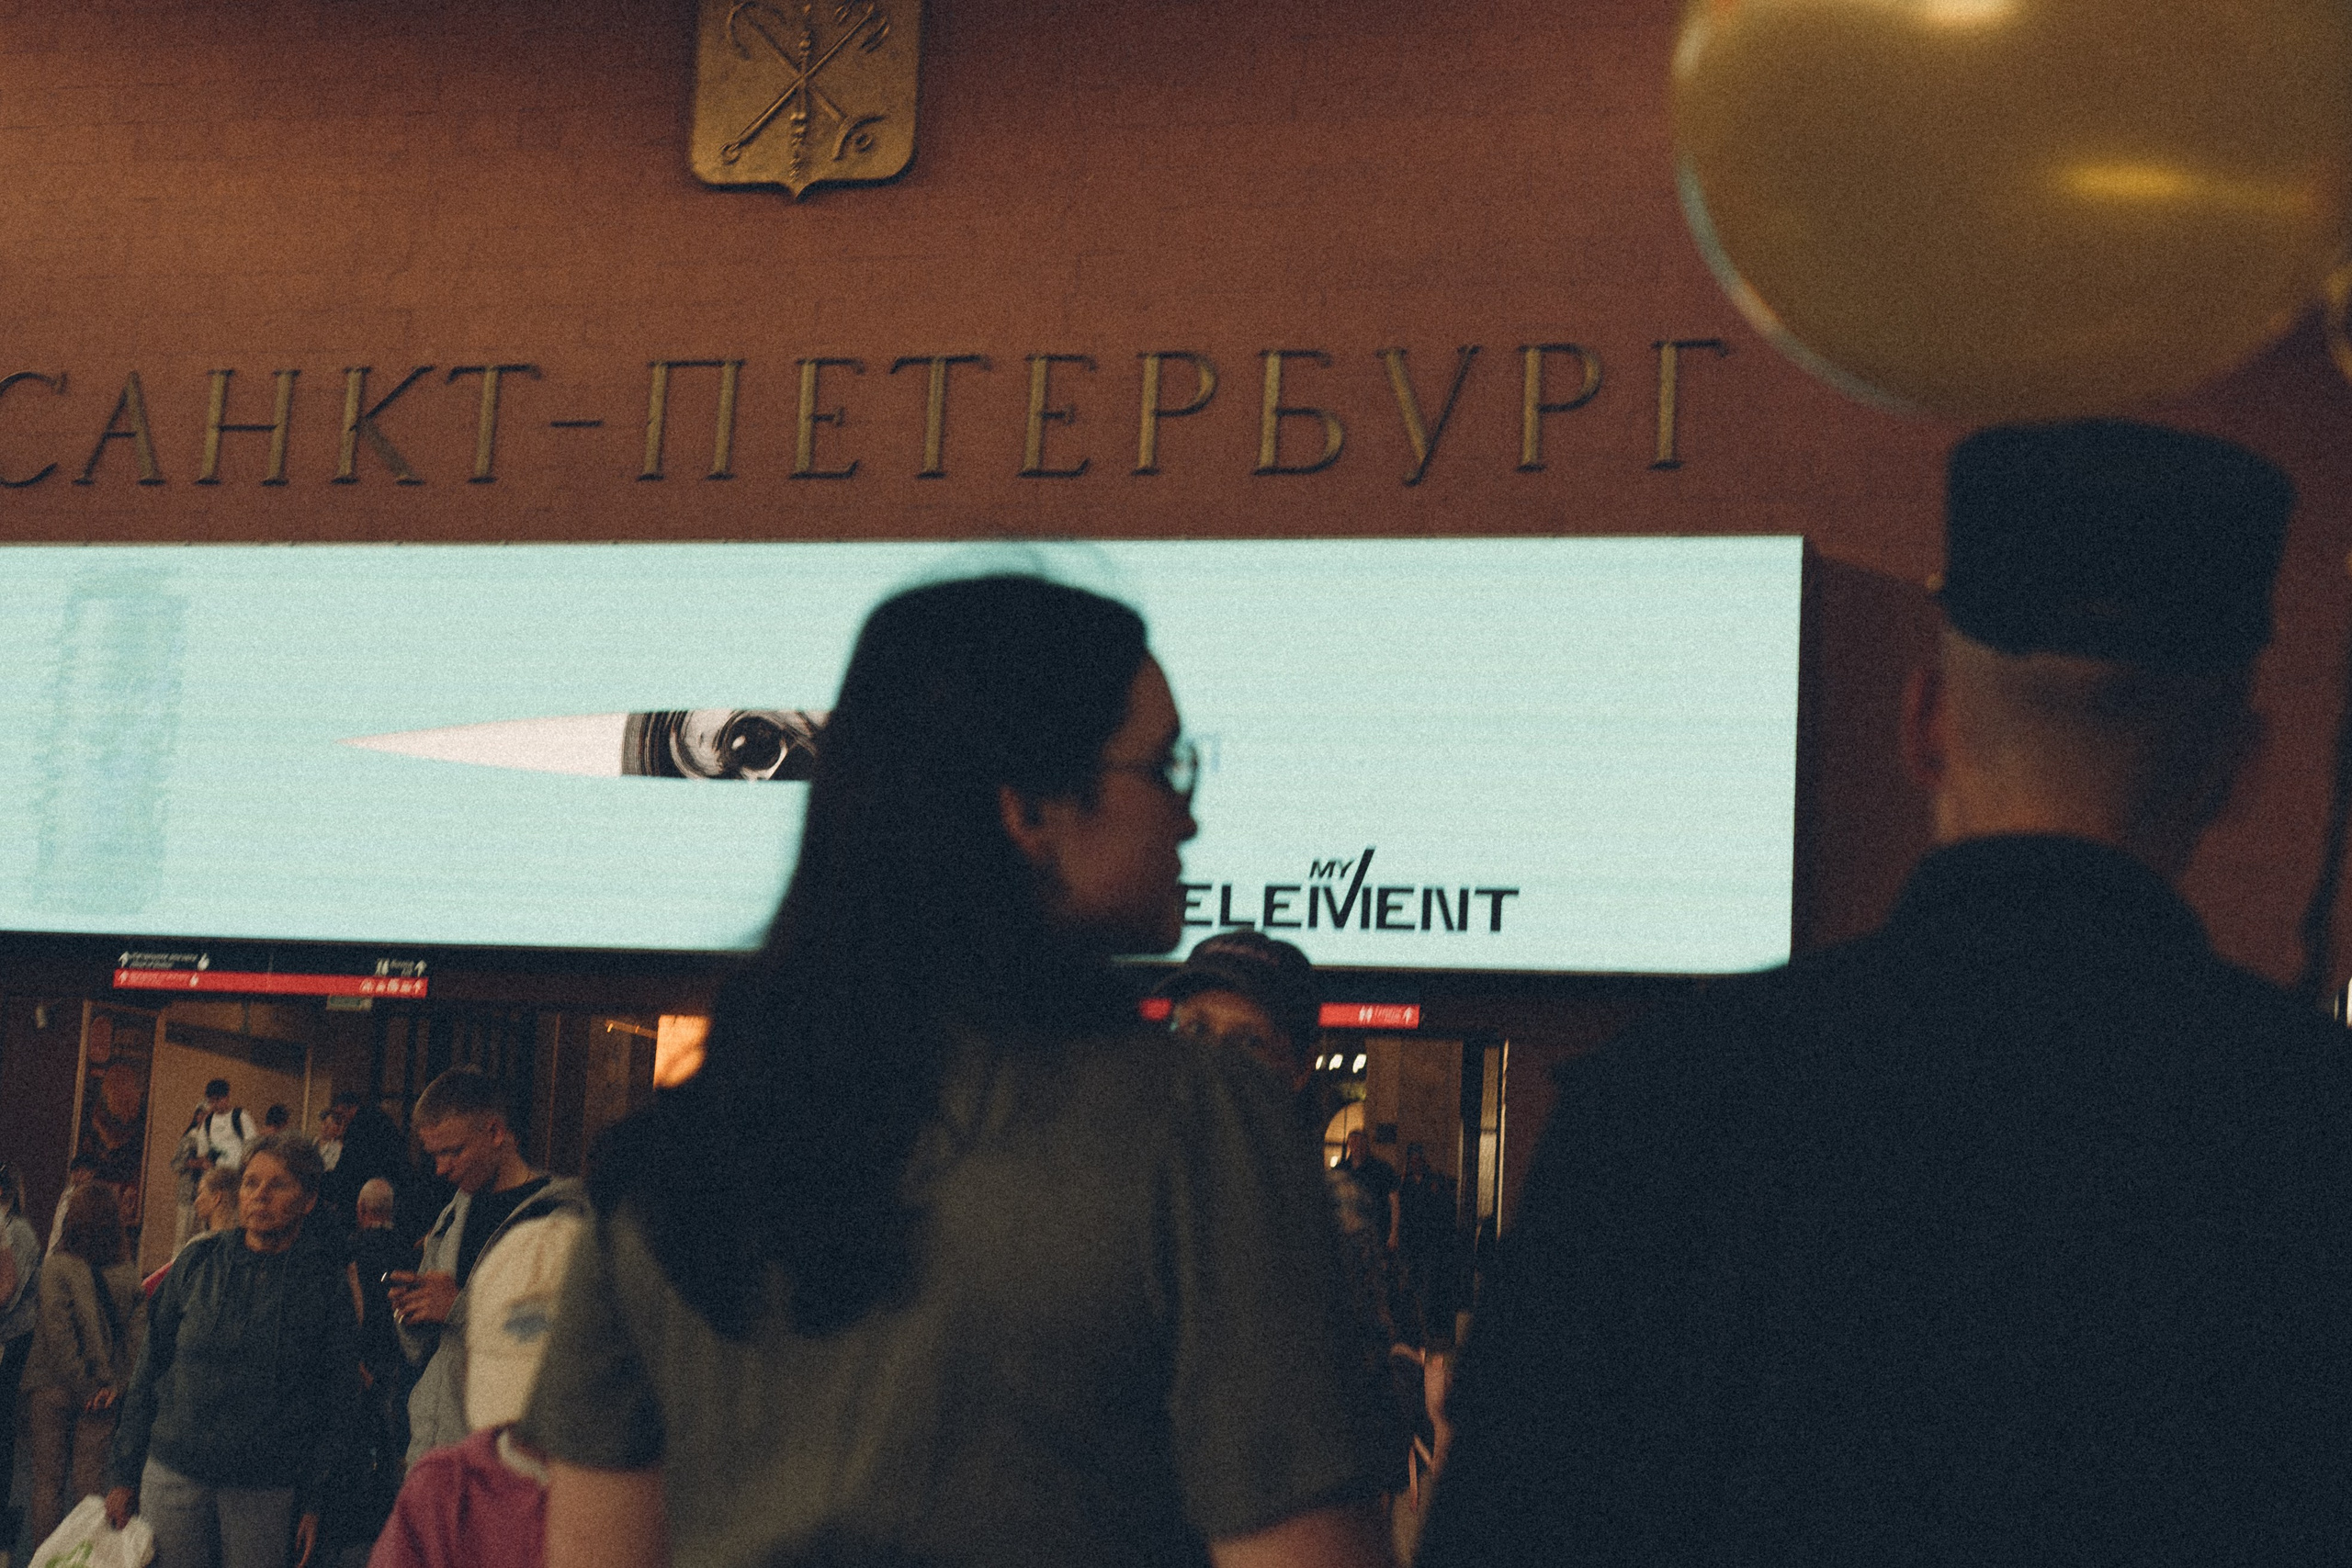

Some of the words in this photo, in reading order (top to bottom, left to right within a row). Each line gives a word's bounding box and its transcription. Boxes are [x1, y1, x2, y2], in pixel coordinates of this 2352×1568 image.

[0, 339, 1733, 487] САНКТ-ПЕТЕРБУРГ
[1182, 847, 1521, 932] ELEMENT
[1309, 858, 1356, 880] MY
